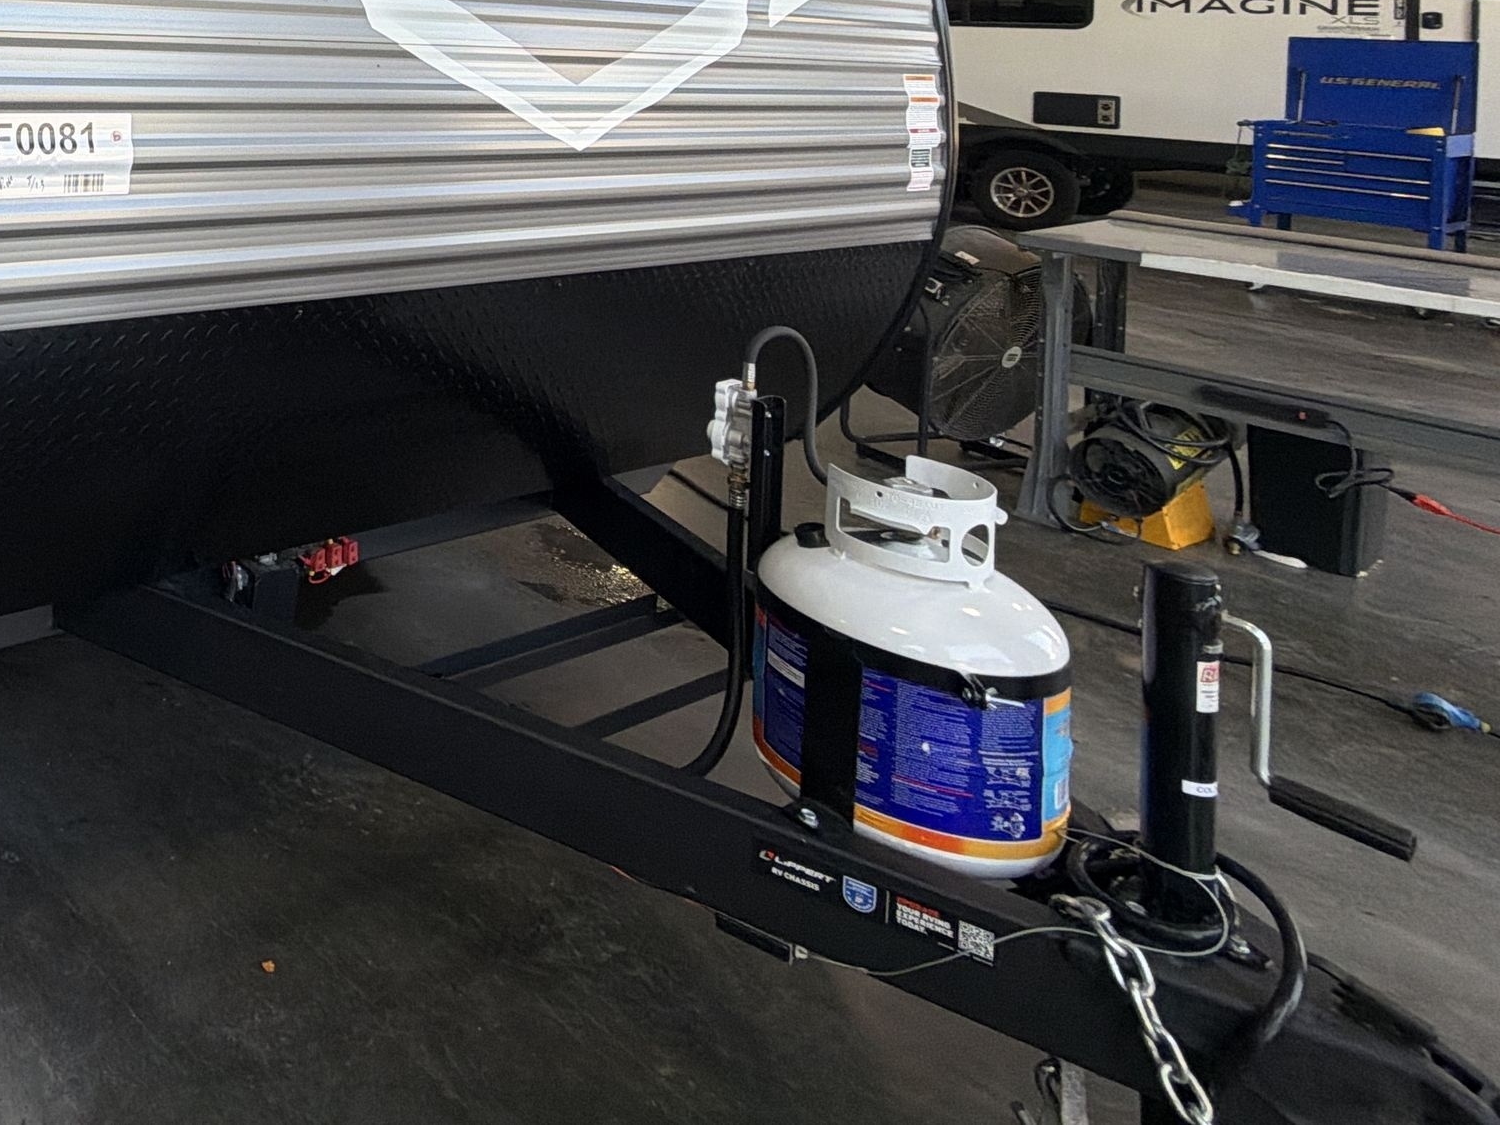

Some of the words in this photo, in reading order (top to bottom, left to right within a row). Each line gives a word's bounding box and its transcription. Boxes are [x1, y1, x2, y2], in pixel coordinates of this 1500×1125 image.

[1331, 15, 1380, 26] XLS
[1351, 77, 1442, 90] GENERAL
[771, 866, 783, 877] RV
[783, 871, 820, 891] CHASSIS
[775, 854, 836, 884] LIPPERT
[896, 902, 921, 918] YOUR
[895, 909, 955, 939] EXPERIENCE
